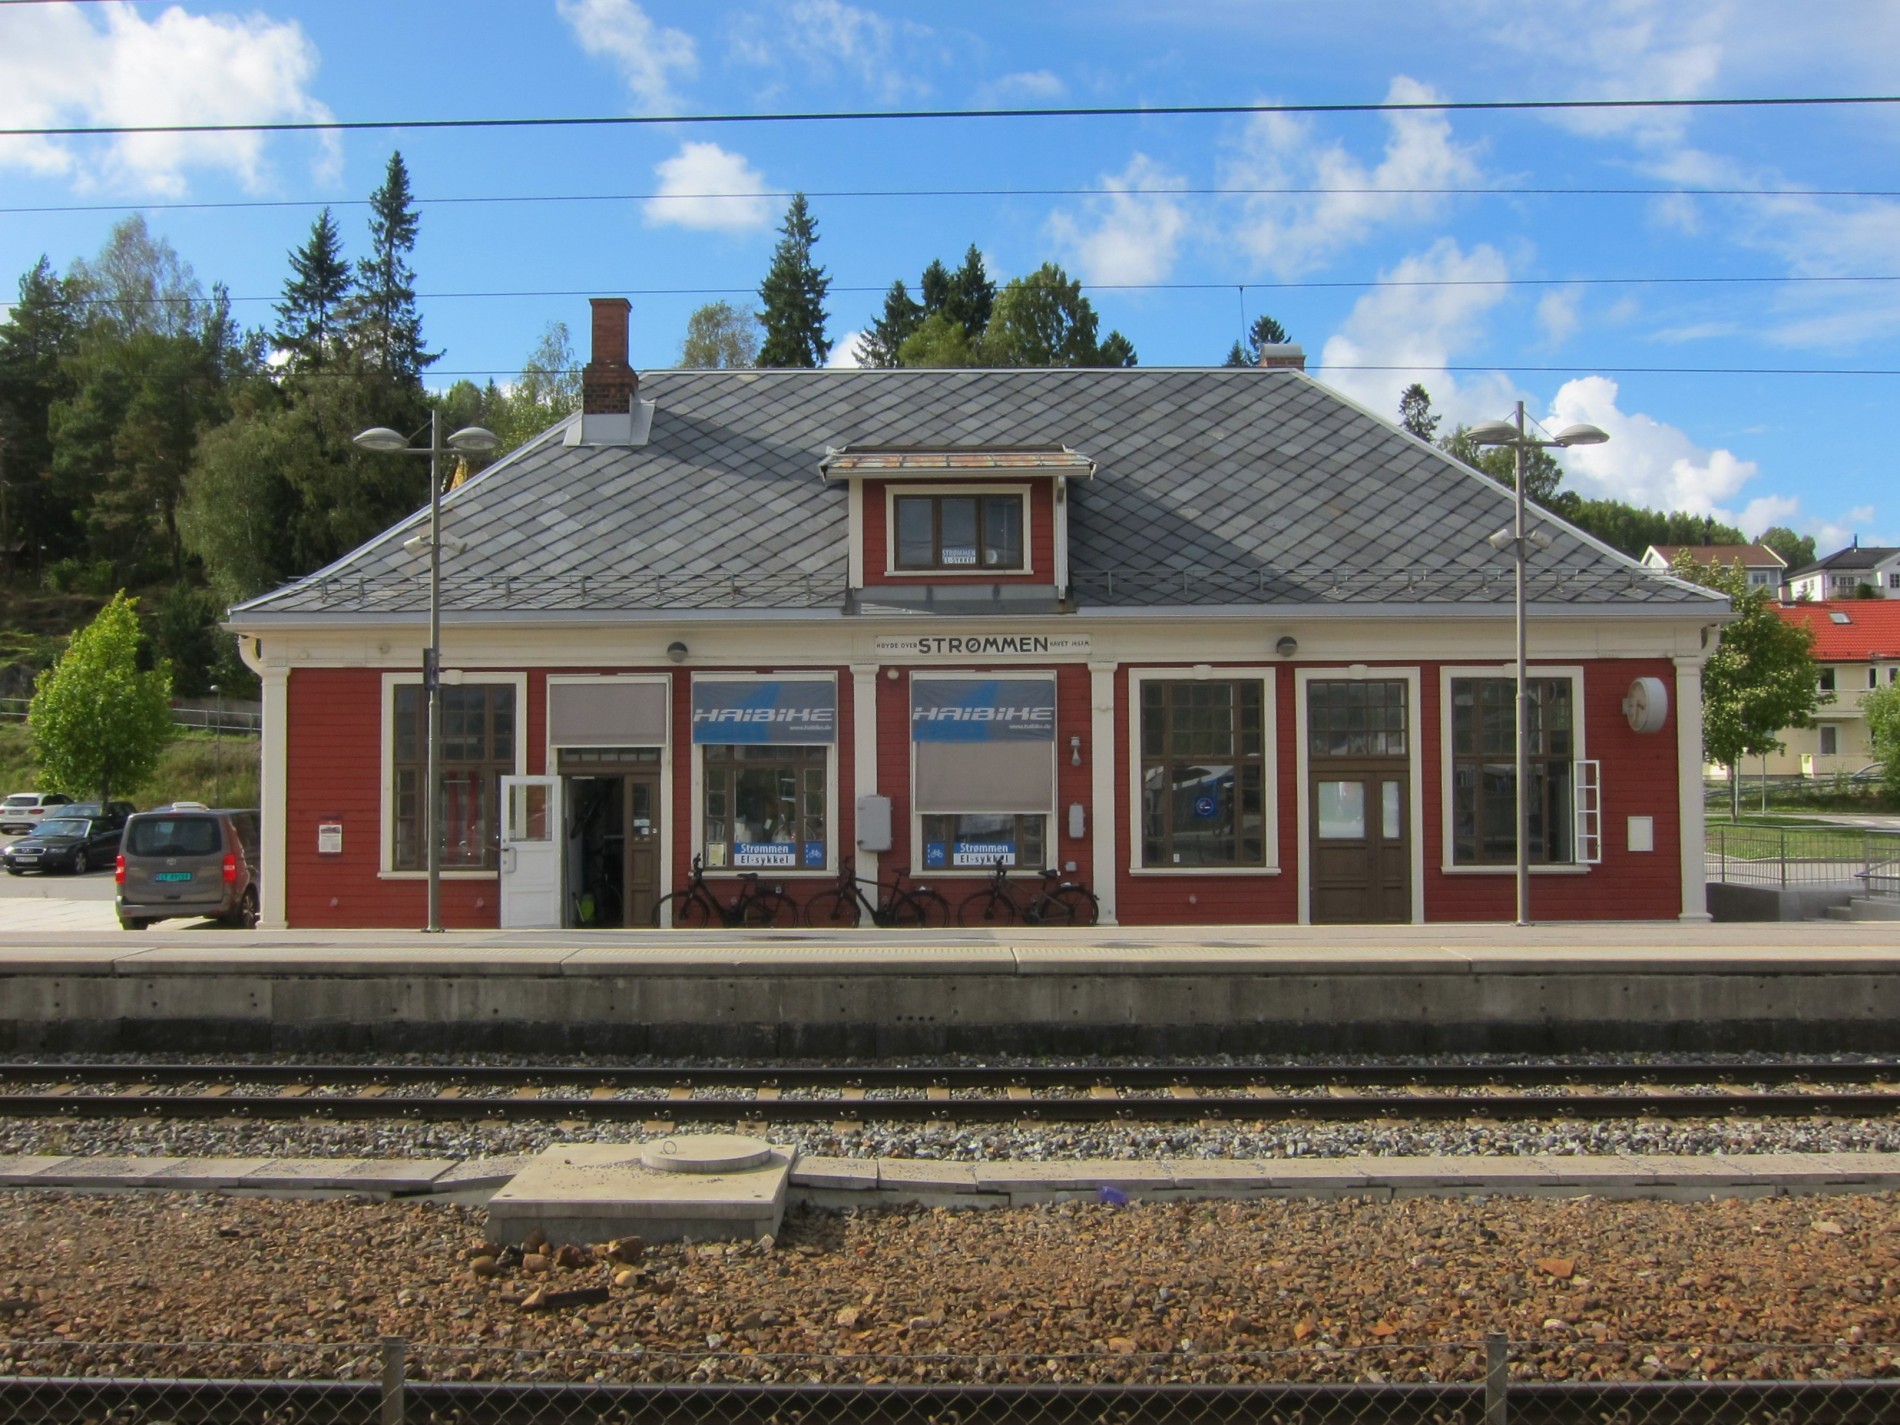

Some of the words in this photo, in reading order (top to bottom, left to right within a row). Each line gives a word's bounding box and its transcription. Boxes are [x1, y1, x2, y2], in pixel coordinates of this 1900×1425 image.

[918, 637, 1048, 654] STRØMMEN
[740, 843, 789, 854] Strømmen
[960, 842, 1009, 853] Strømmen
[740, 855, 789, 866] El-sykkel
